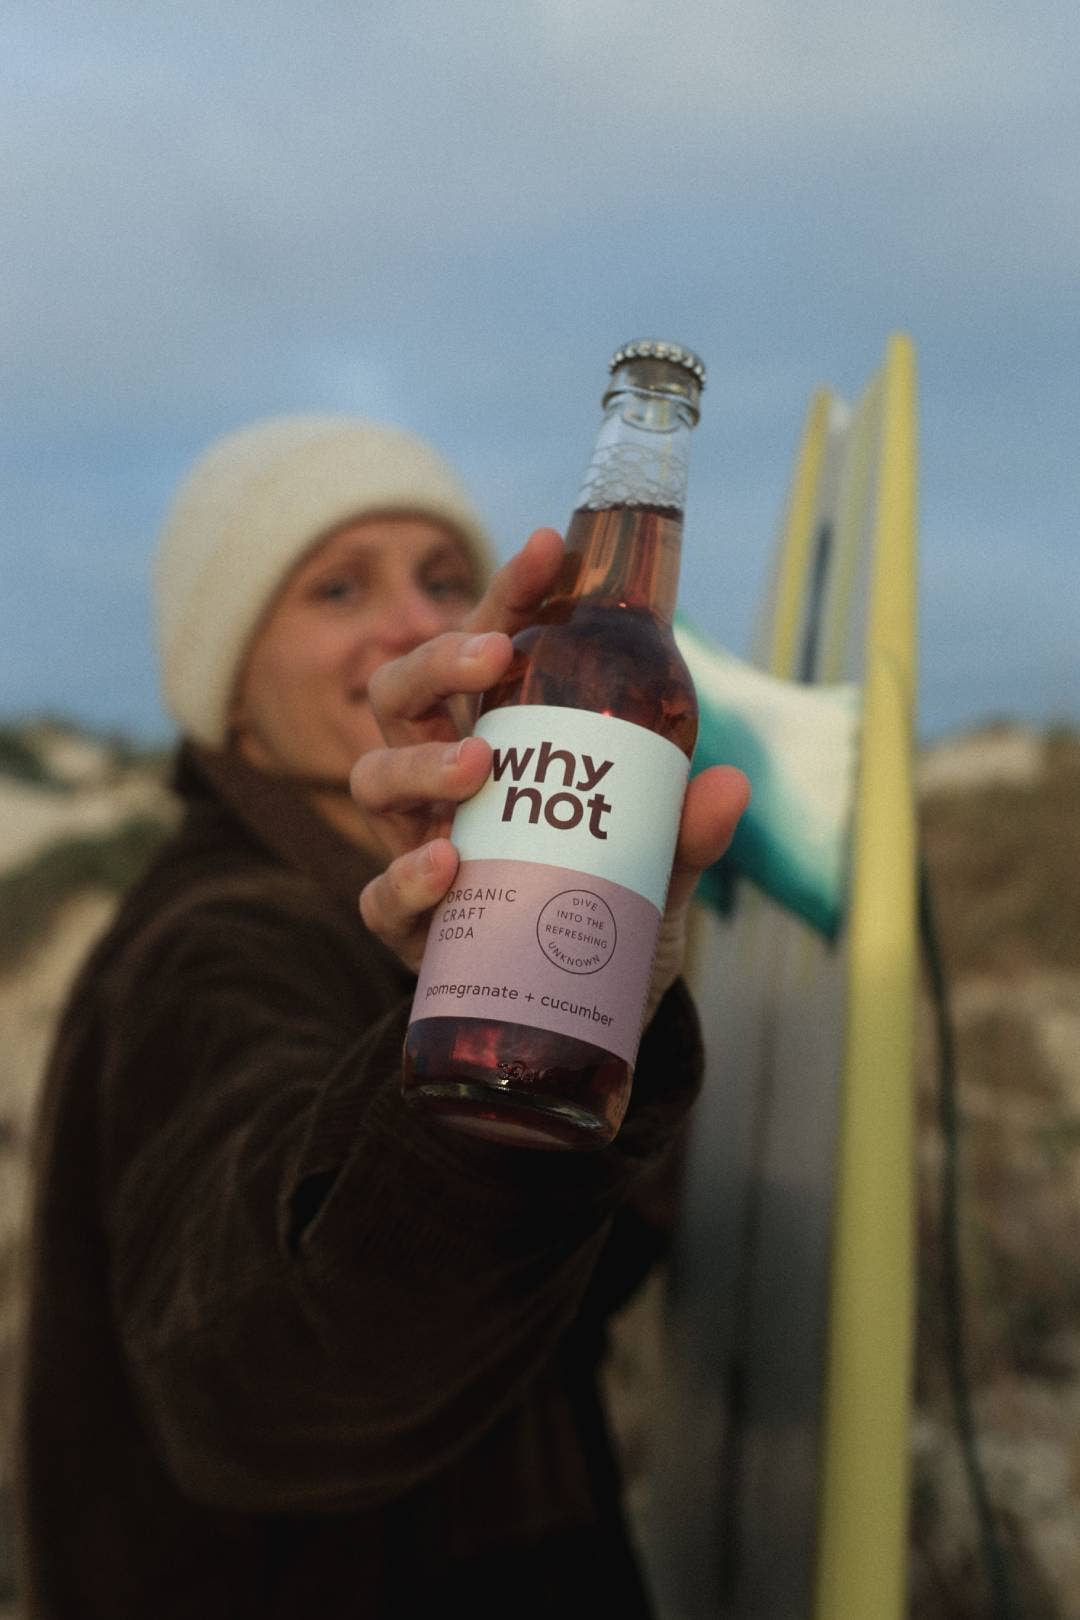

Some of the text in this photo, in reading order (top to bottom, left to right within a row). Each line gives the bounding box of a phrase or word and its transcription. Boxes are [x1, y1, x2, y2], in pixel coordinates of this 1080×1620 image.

[492, 741, 615, 791] why
[501, 786, 612, 840] not
[447, 888, 517, 903] ORGANIC
[572, 898, 598, 911] DIVE
[442, 907, 486, 922] CRAFT
[557, 910, 605, 930] INTO THE
[438, 926, 474, 941] SODA
[545, 924, 607, 949] REFRESHING
[548, 941, 600, 968] UNKNOWN
[425, 983, 518, 1000] pomegranate
[541, 995, 614, 1026] cucumber
